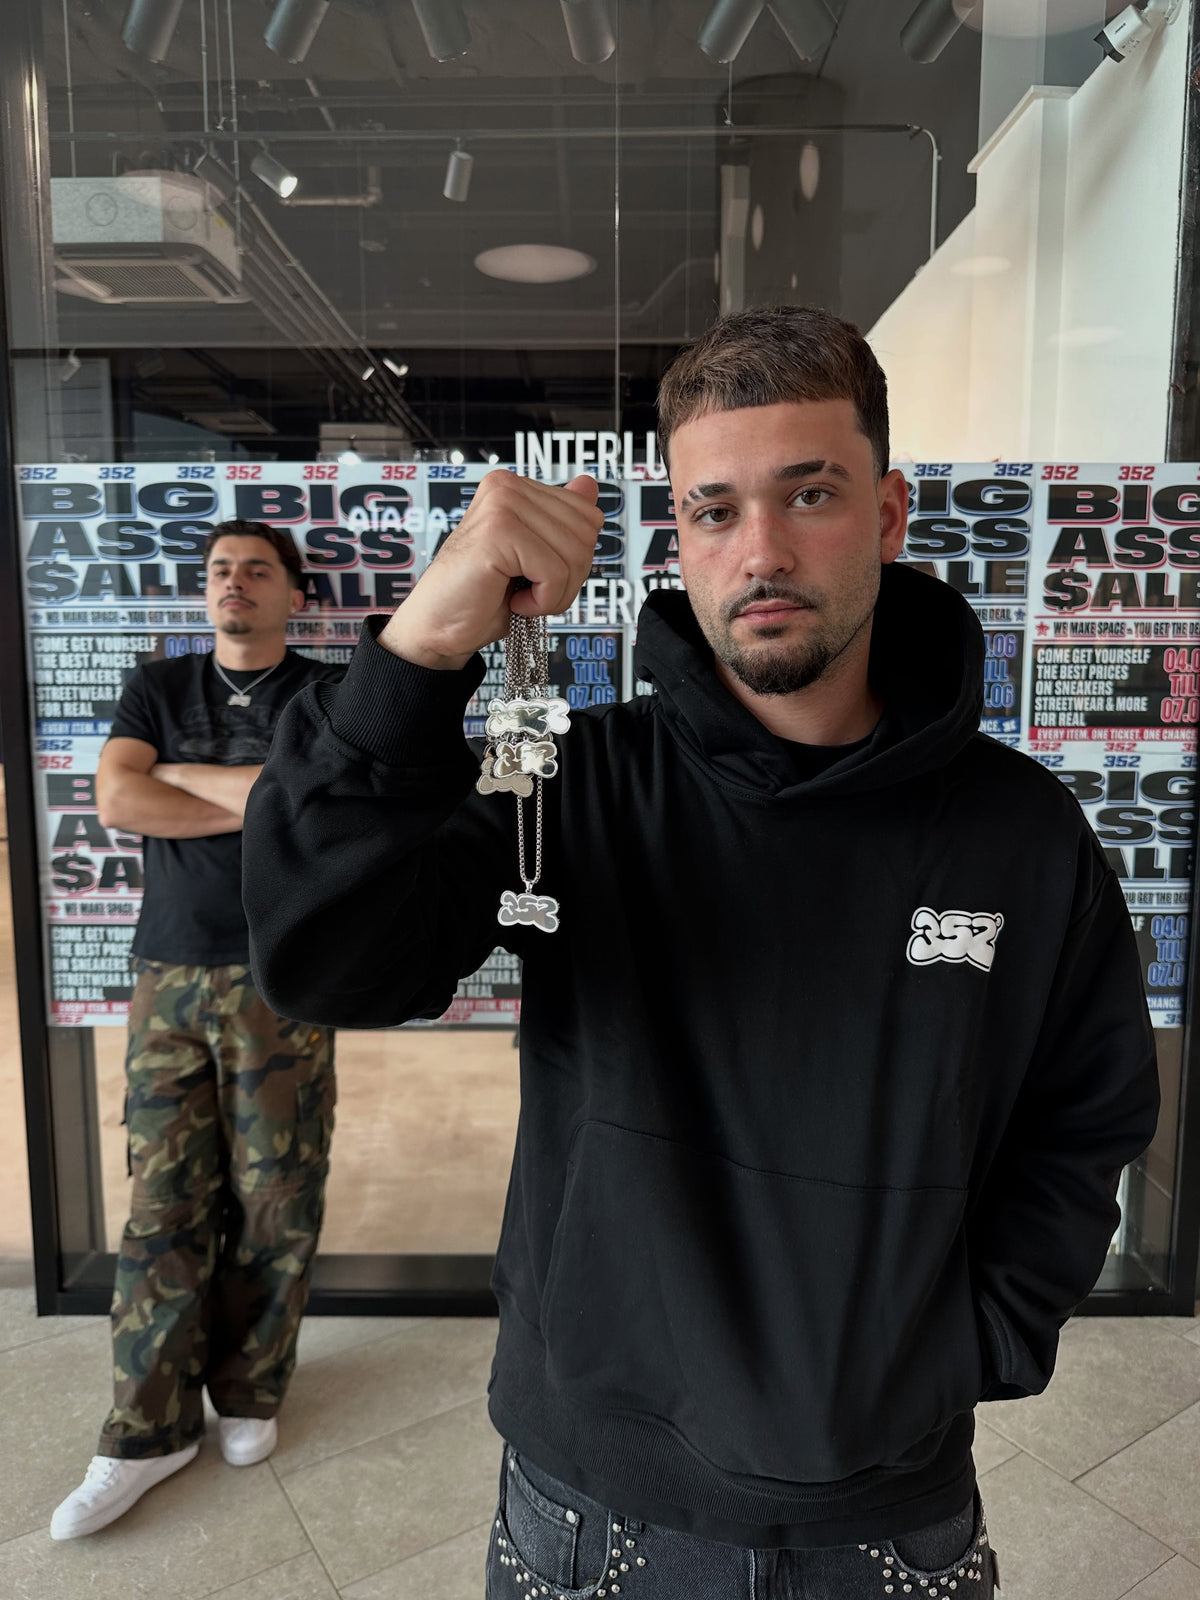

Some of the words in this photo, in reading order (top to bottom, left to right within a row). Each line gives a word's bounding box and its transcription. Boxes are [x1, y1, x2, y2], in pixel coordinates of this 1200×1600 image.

[20, 467, 57, 480] 352
[98, 467, 135, 479] 352
[177, 466, 215, 479] 352
[226, 465, 262, 480] 352
[303, 465, 340, 480] 352
[381, 465, 417, 480] 352
[427, 466, 467, 479] 352
[914, 463, 952, 477] 352
[994, 463, 1033, 477] 352
[1041, 465, 1079, 480] 352
[1118, 466, 1155, 480] 352
[21, 482, 219, 520] BIG
[235, 484, 415, 526] BIG
[26, 520, 211, 562] ASS
[899, 518, 1031, 559] SS
[27, 561, 207, 605] $ALE
[301, 573, 417, 611] ALE
[46, 611, 59, 624] WE
[63, 611, 88, 624] MAKE
[91, 611, 118, 624] SPACE
[128, 611, 146, 624] YOU
[149, 611, 164, 624] GET
[167, 611, 182, 624] THE
[186, 611, 208, 624] DEAL
[989, 608, 1012, 621] DEAL
[1054, 621, 1068, 637] WE
[1070, 621, 1096, 637] MAKE
[1098, 621, 1126, 637] SPACE
[1134, 621, 1151, 637] YOU
[1154, 621, 1169, 637] GET
[1172, 621, 1187, 637] THE
[1189, 621, 1200, 637] DE
[34, 636, 69, 652] COME
[71, 636, 94, 652] GET
[95, 636, 158, 652] YOURSELF
[566, 636, 617, 660] 04.06
[984, 634, 1016, 658] .06
[35, 652, 58, 668] THE
[59, 653, 90, 668] BEST
[91, 653, 137, 669] PRICES
[1036, 648, 1071, 663] COME
[1072, 648, 1094, 664] GET
[1095, 648, 1151, 664] YOURSELF
[1163, 647, 1200, 673] 04.0
[55, 670, 122, 685] SNEAKERS
[572, 661, 610, 685] TILL
[983, 659, 1010, 683] ILL
[1036, 665, 1059, 679] THE
[1060, 665, 1088, 680] BEST
[1089, 665, 1130, 680] PRICES
[36, 685, 114, 701] STREETWEAR
[1035, 680, 1052, 695] ON
[1054, 680, 1114, 696] SNEAKERS
[984, 684, 1015, 709] .06
[1035, 697, 1104, 711] STREETWEAR
[1105, 697, 1114, 711] &
[1116, 697, 1149, 711] MORE
[37, 702, 61, 717] FOR
[62, 702, 95, 717] REAL
[1161, 697, 1200, 723] 07.0
[981, 720, 1001, 733] NCE.
[1034, 712, 1055, 726] FOR
[1058, 712, 1087, 726] REAL
[41, 721, 69, 734] EVERY
[1037, 729, 1064, 741] EVERY
[1066, 729, 1088, 741] ITEM.
[1091, 729, 1108, 741] ONE
[1110, 729, 1141, 741] TICKET.
[1143, 729, 1160, 741] ONE
[1104, 742, 1137, 752] 352
[38, 755, 73, 769] 352
[1103, 755, 1141, 768] 352
[1095, 807, 1194, 845] SS
[51, 852, 144, 896] $A
[1137, 891, 1154, 904] GET
[1156, 892, 1172, 904] THE
[80, 903, 105, 916] MAKE
[107, 903, 134, 916] SPACE
[498, 890, 560, 933] 352
[51, 926, 83, 942] COME
[84, 926, 105, 942] GET
[1150, 915, 1188, 939] 04.0
[52, 942, 72, 957] THE
[74, 942, 101, 957] BEST
[1156, 939, 1187, 963] TIL
[71, 957, 129, 972] SNEAKERS
[53, 972, 122, 987] STREETWEAR
[1147, 962, 1185, 987] 07.0
[54, 987, 76, 1001] FOR
[78, 987, 105, 1001] REAL
